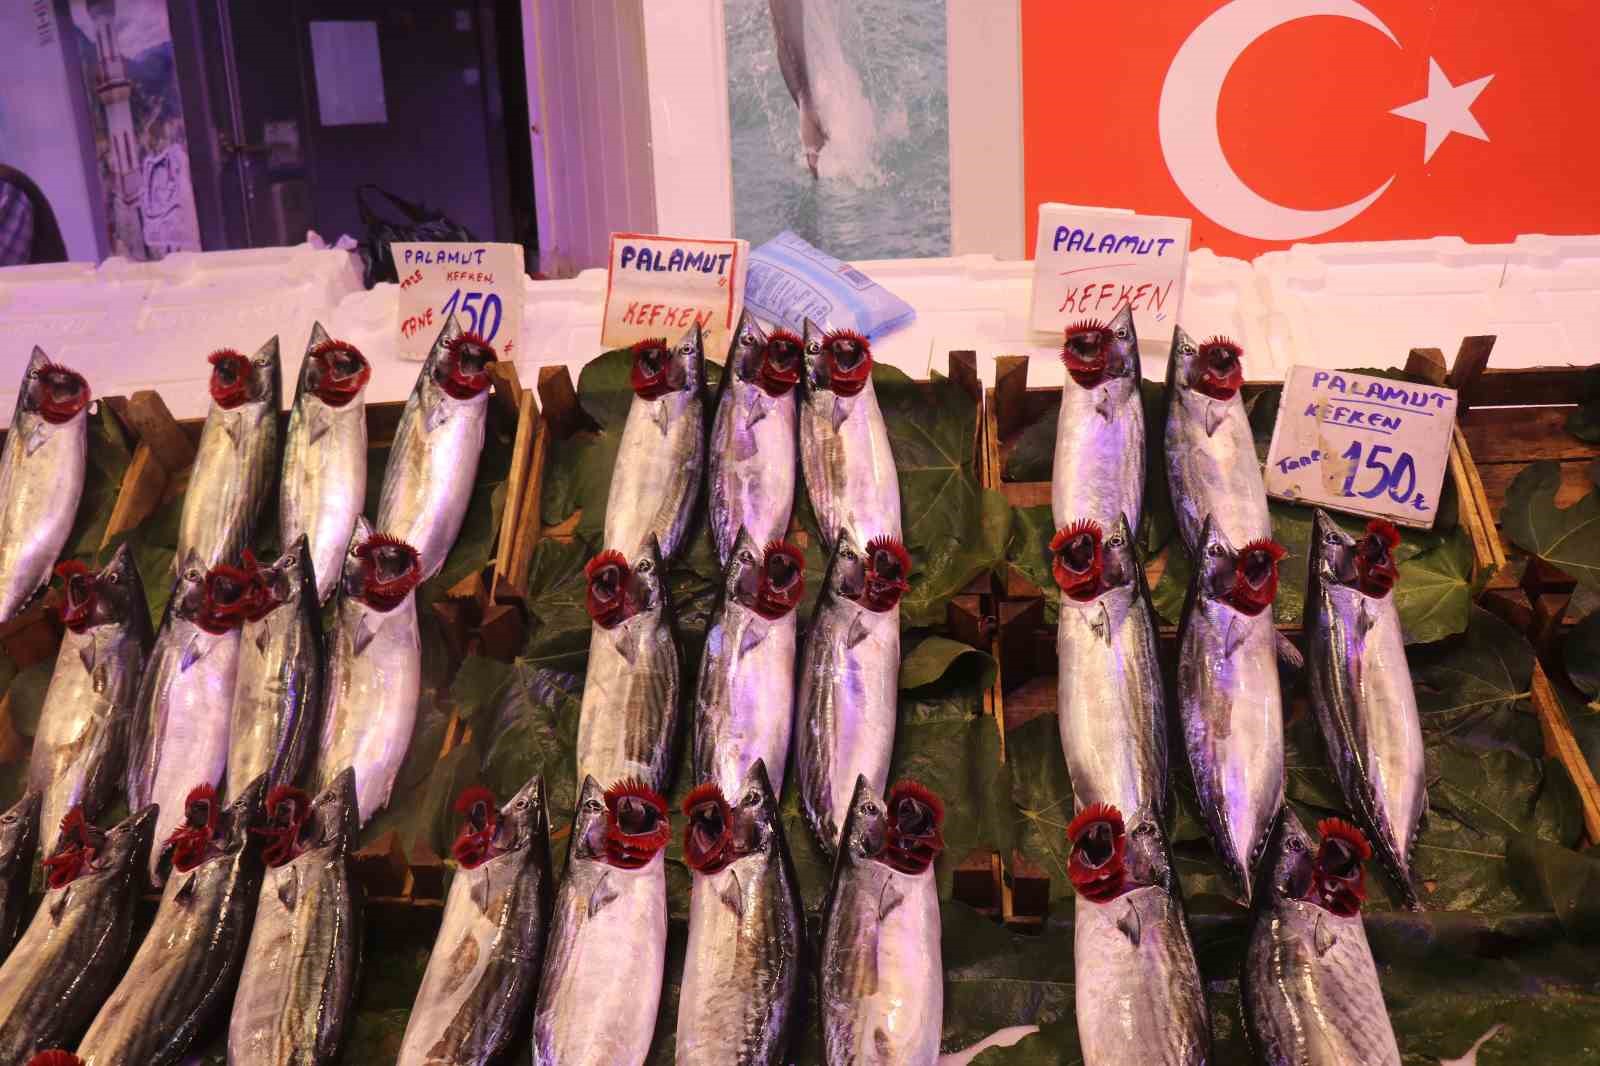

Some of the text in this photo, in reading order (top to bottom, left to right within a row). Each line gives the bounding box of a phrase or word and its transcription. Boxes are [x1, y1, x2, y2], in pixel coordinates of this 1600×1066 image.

[1053, 225, 1174, 256] PALAMUT
[404, 249, 486, 264] PALAMUT
[621, 246, 732, 275] PALAMUT
[1058, 280, 1173, 313] KEFKEN
[623, 302, 713, 327] KEFKEN
[1312, 372, 1453, 408] PALAMUT
[1304, 403, 1402, 431] KEFKEN
